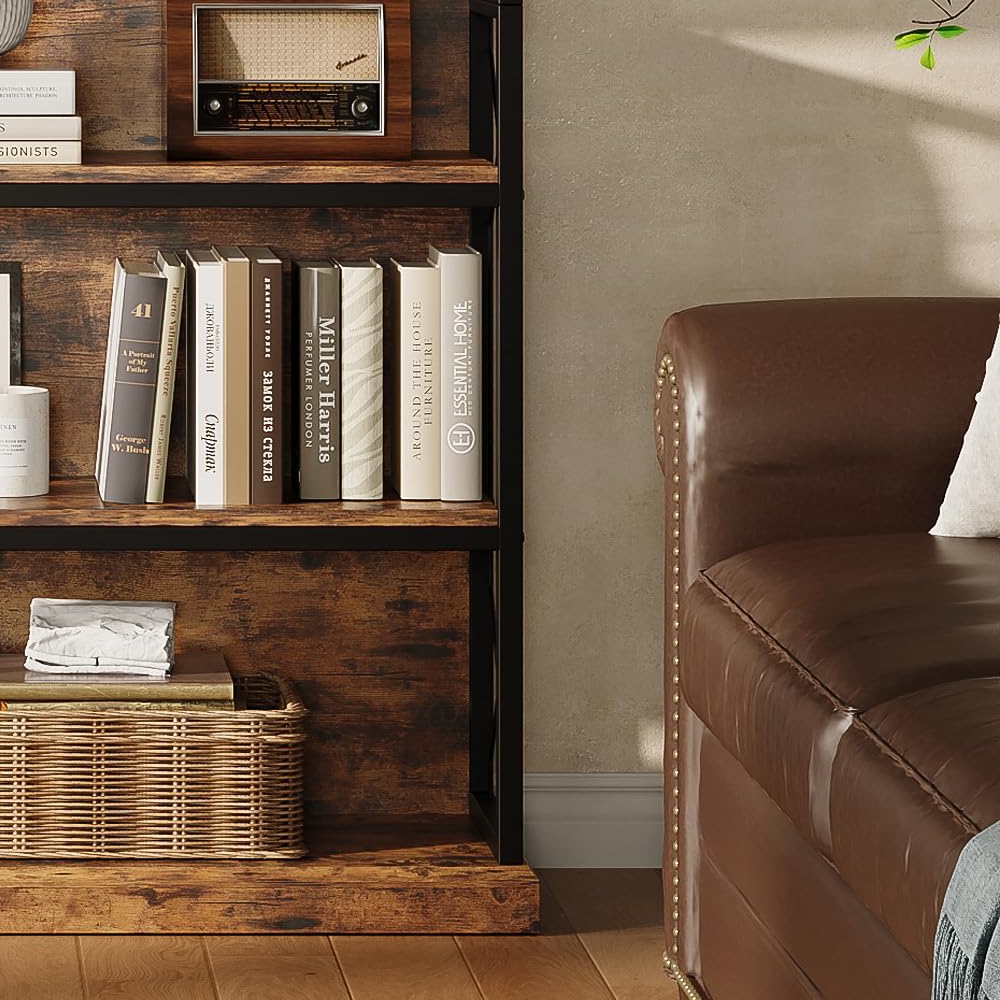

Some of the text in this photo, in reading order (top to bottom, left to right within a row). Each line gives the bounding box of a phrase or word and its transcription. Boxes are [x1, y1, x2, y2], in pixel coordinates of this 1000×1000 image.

[130, 303, 152, 319] 41
[162, 286, 180, 398] Puerto Vallarta Squeeze
[205, 303, 215, 372] ДЖОВАНЬОЛИ
[121, 349, 155, 359] A Portrait
[126, 365, 149, 374] Father
[136, 359, 147, 367] My
[412, 300, 421, 461] AROUND THE HOUSE
[424, 337, 433, 425] FURNITURE
[453, 301, 467, 416] ESSENTIAL HOME
[305, 331, 313, 448] PERFUMER LONDON
[318, 315, 336, 464] Miller Harris
[111, 443, 151, 455] W. Bush
[115, 433, 147, 445] George
[200, 413, 219, 473] Спартак
